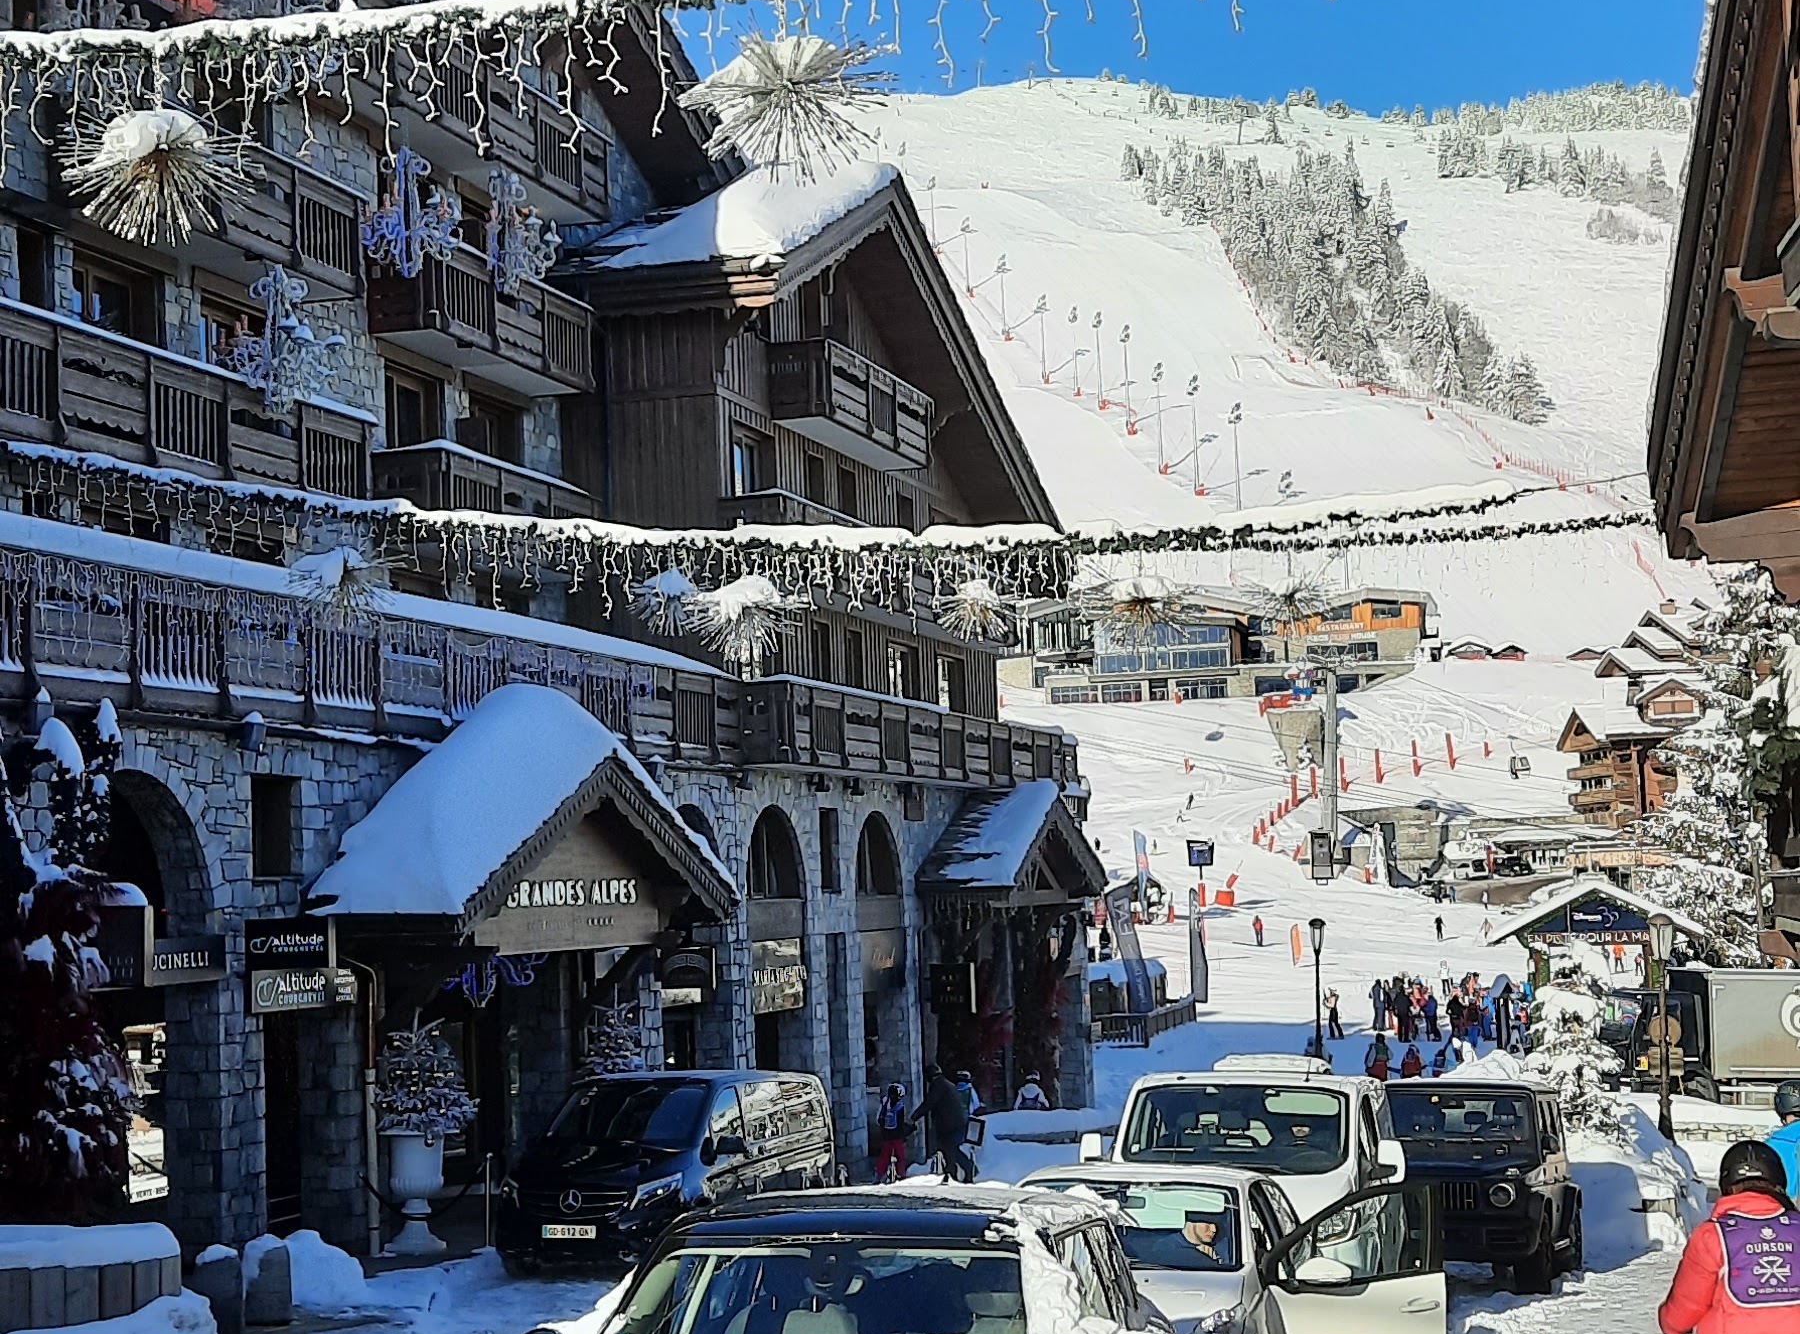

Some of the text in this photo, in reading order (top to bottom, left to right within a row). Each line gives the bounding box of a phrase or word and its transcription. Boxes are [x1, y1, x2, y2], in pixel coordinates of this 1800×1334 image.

[507, 878, 637, 908] GRANDES ALPES
[1527, 934, 1542, 943] EN
[1615, 933, 1629, 942] LA
[1746, 1242, 1793, 1254] OURSON
